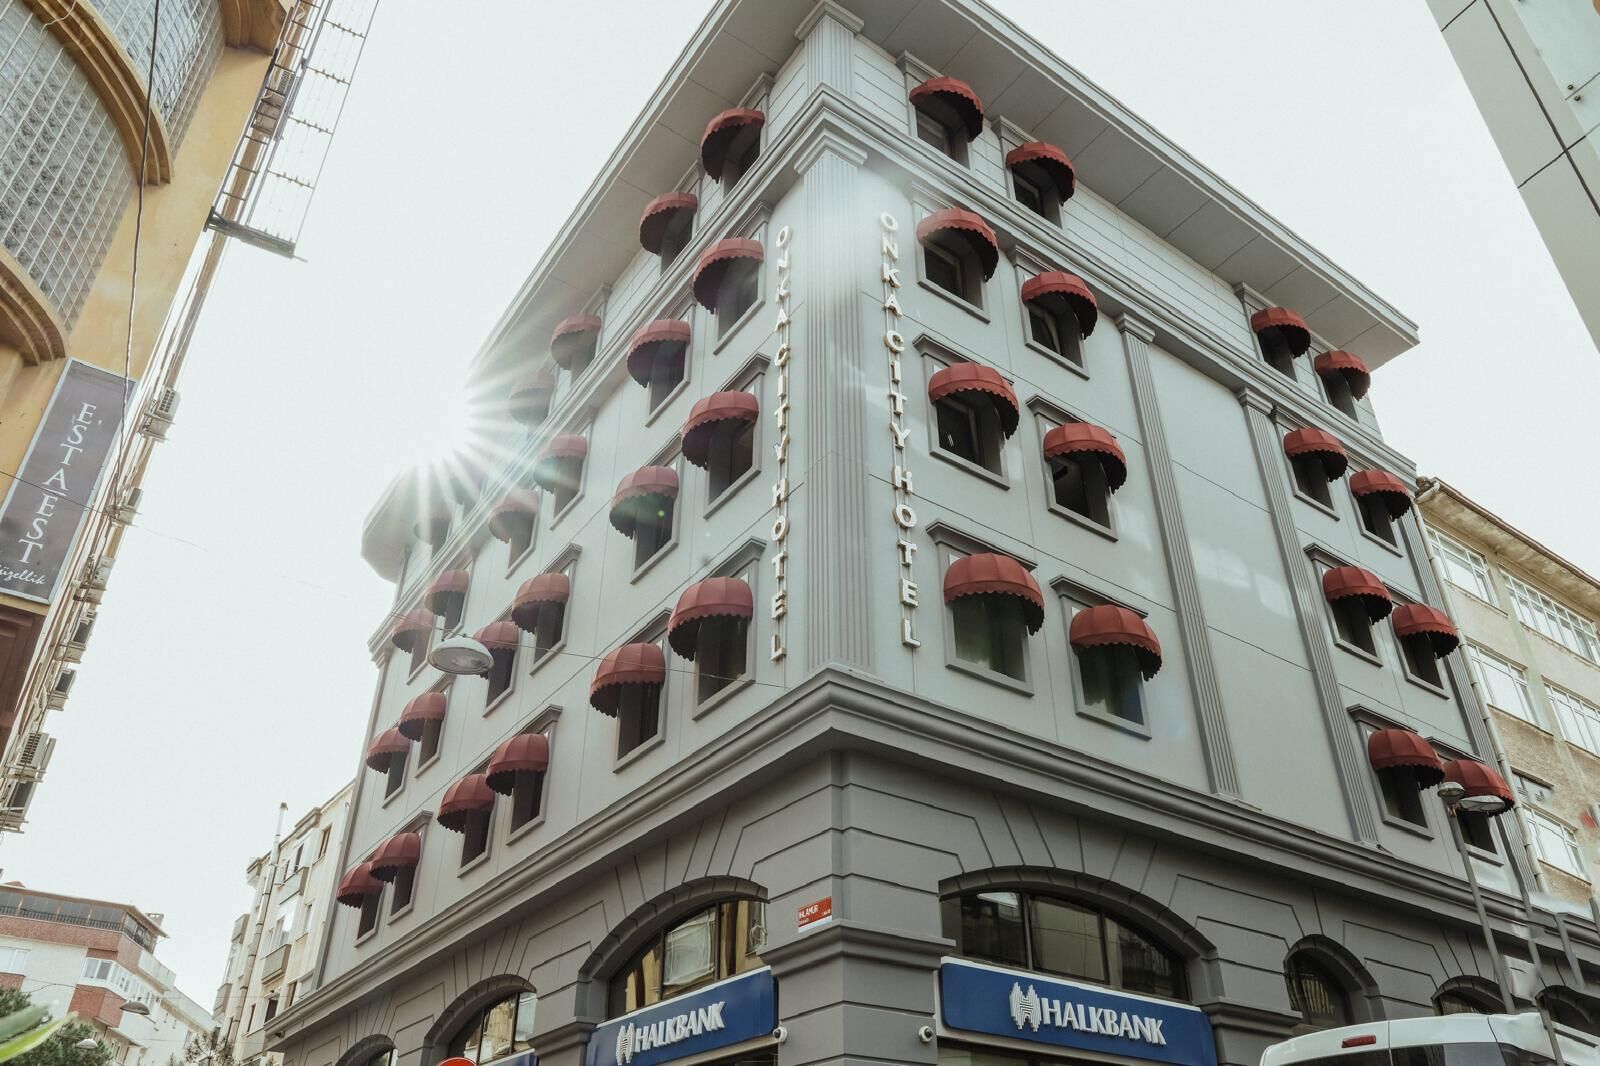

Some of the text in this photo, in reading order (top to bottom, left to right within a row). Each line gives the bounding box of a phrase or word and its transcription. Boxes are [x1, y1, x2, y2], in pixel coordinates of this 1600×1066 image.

[771, 225, 791, 662] ONKA CITY HOTEL
[880, 212, 921, 648] ONKA CITY HOTEL
[0, 564, 46, 586] üzellik
[634, 1001, 725, 1053] HALKBANK
[1041, 997, 1167, 1046] HALKBANK
